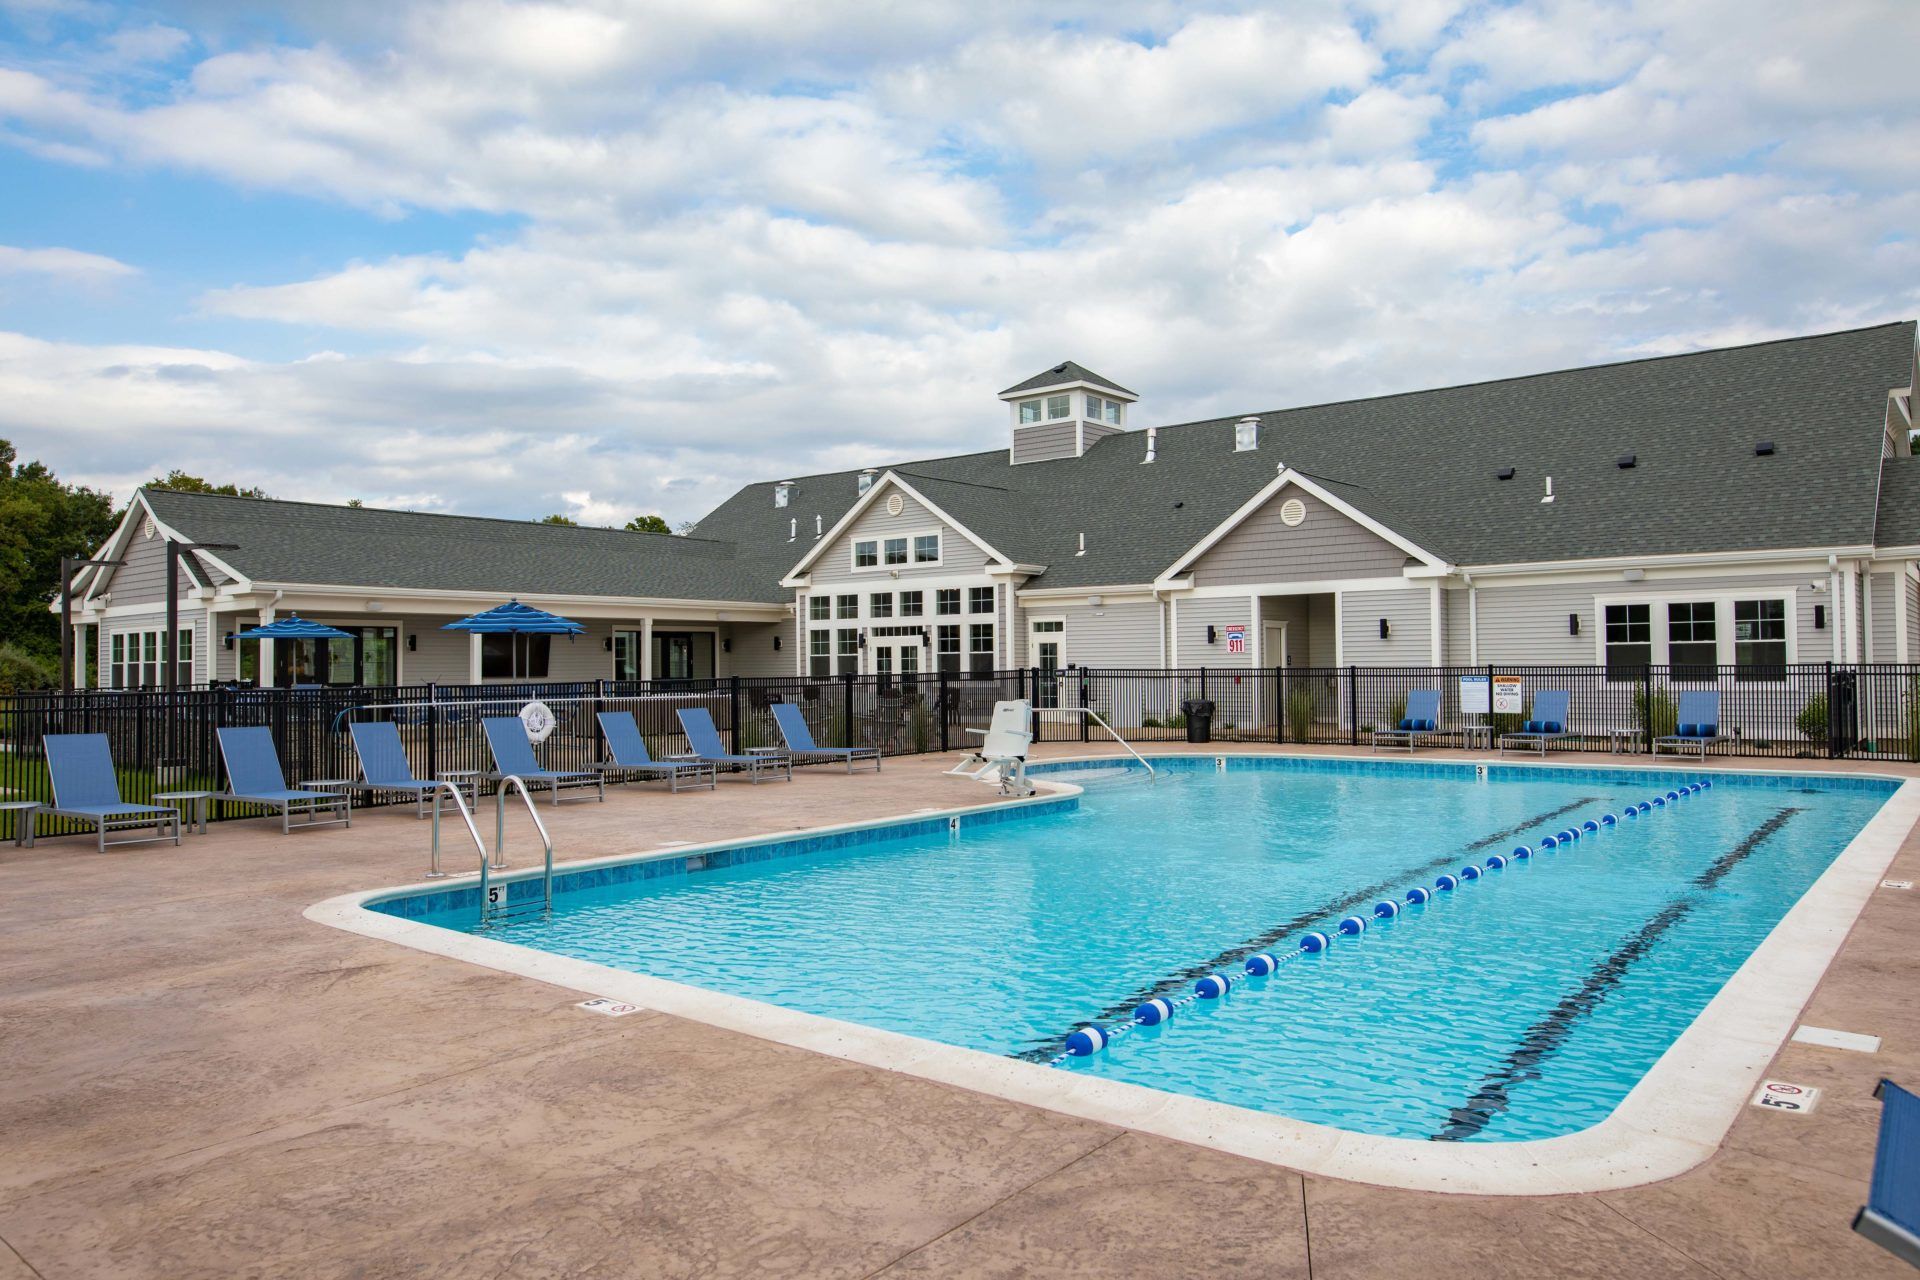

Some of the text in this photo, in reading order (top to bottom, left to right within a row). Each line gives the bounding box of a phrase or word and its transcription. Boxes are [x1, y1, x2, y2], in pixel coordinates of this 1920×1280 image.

[1229, 639, 1243, 652] 911
[1216, 758, 1222, 766] 3
[1477, 766, 1483, 775] 3
[950, 818, 956, 830] 4
[489, 887, 499, 903] 5
[1761, 1098, 1801, 1110] 5
